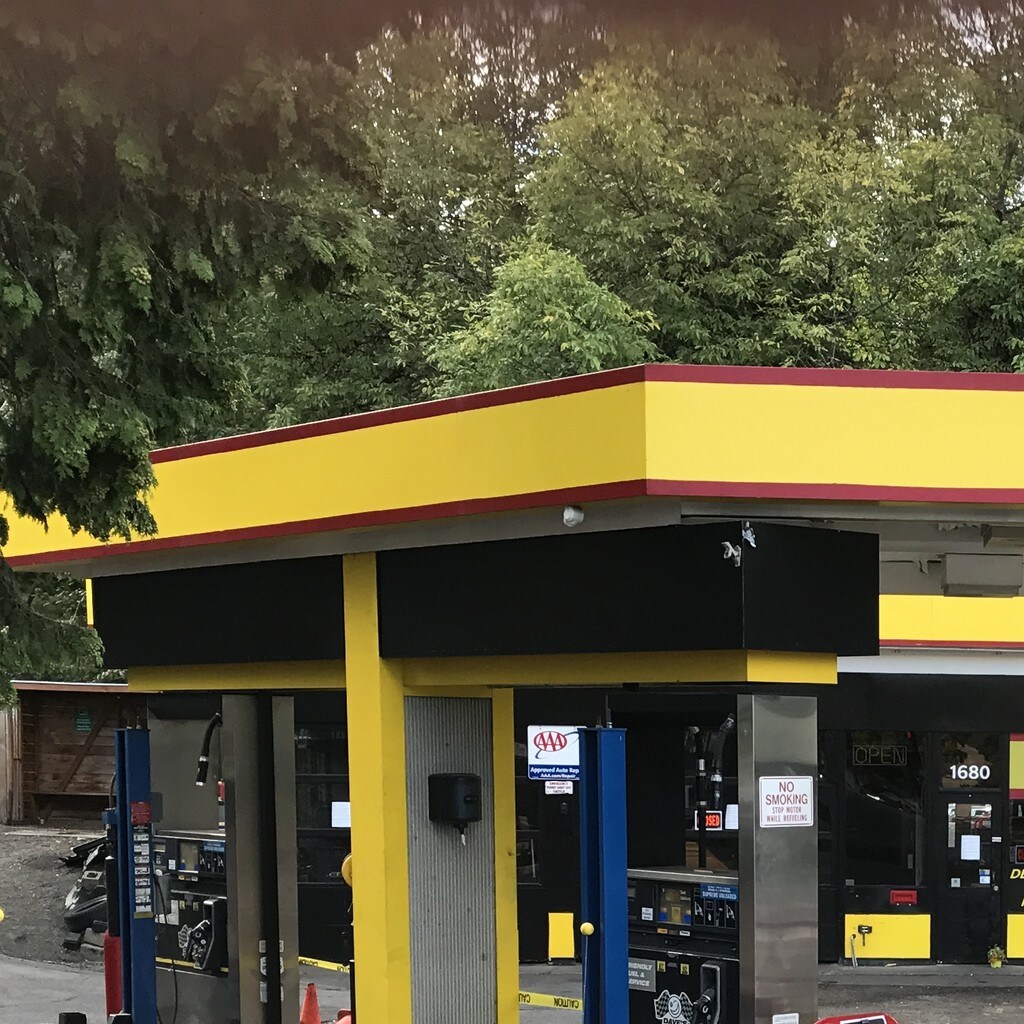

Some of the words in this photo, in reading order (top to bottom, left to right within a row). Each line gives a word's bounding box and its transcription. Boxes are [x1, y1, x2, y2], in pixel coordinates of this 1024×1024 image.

[537, 732, 565, 752] AAA
[855, 747, 905, 764] OPEN
[569, 767, 580, 775] Rep
[949, 765, 991, 780] 1680
[779, 781, 795, 792] NO
[765, 793, 808, 805] SMOKING
[772, 806, 784, 814] STOP
[786, 806, 802, 814] MOTOR
[783, 814, 808, 822] REFUELING
[628, 961, 653, 971] RIENDLY
[628, 978, 650, 987] ERVICE
[553, 997, 580, 1009] CAUTION
